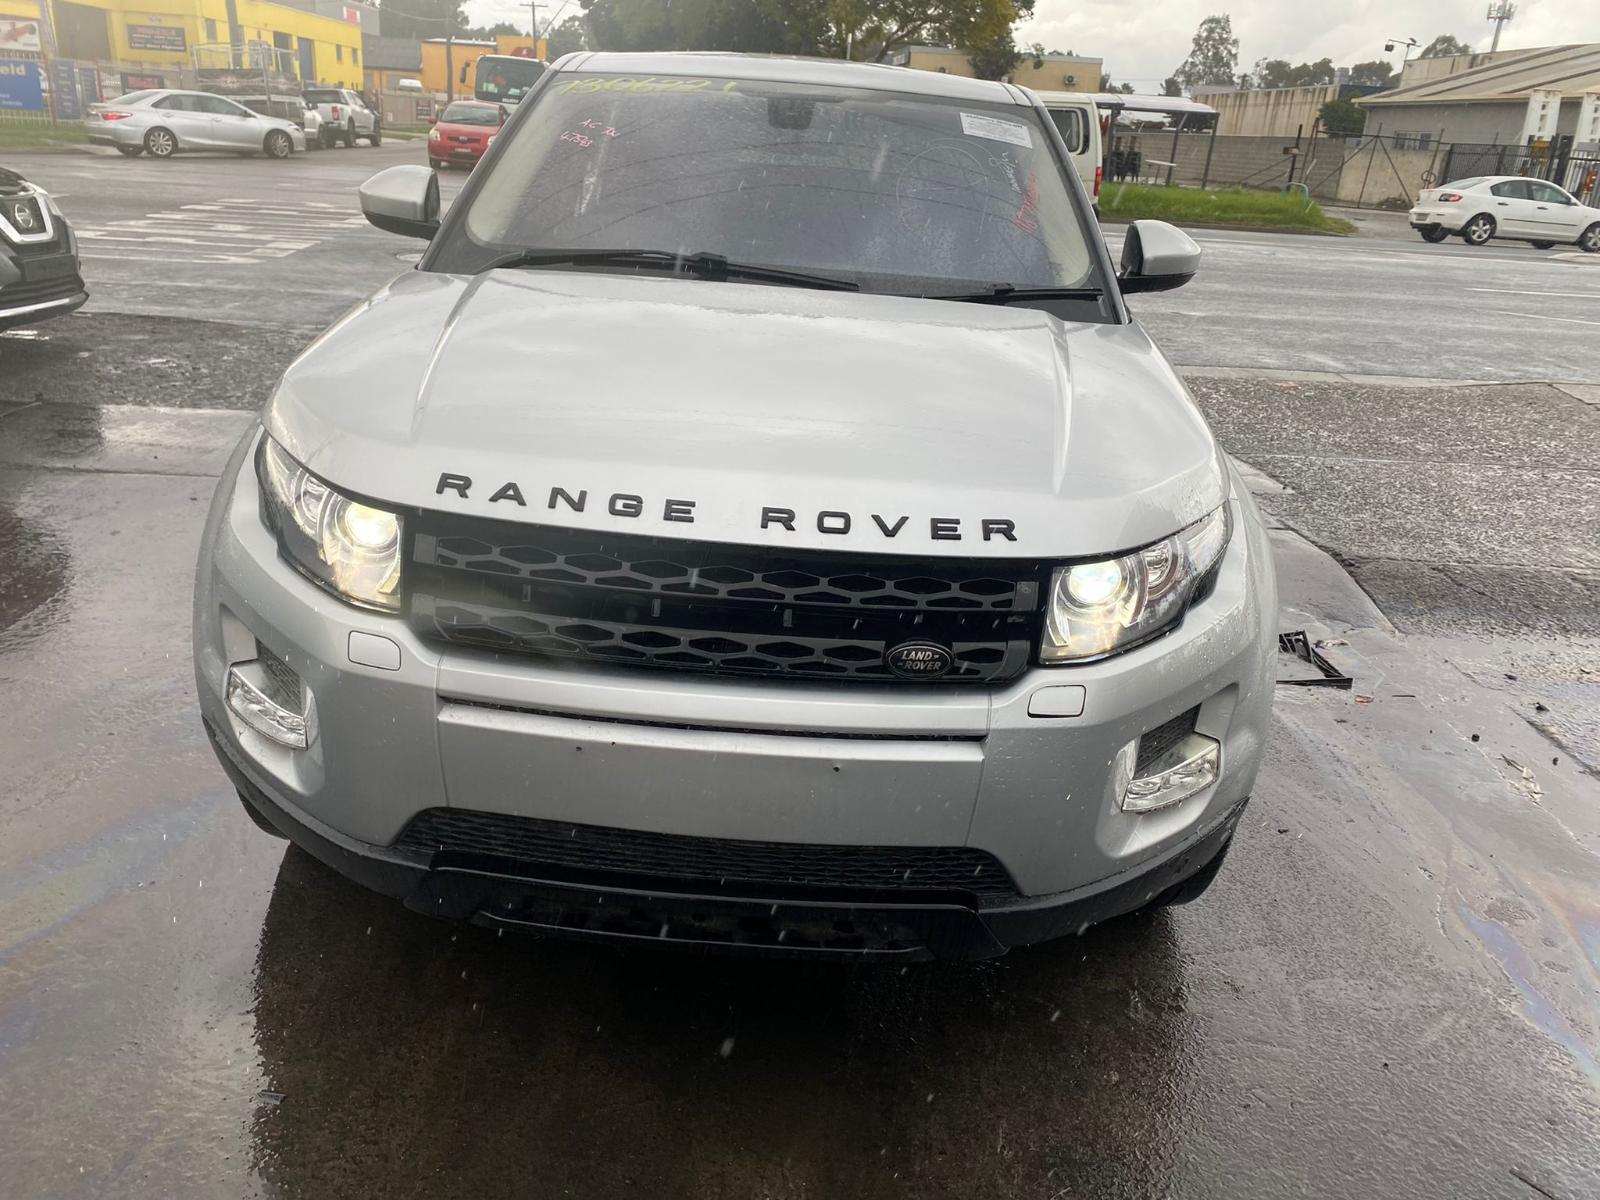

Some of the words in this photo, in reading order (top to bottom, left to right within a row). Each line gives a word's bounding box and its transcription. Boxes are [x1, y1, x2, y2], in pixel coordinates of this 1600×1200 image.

[436, 472, 697, 524] RANGE
[760, 506, 1018, 542] ROVER
[901, 650, 933, 661] LAND
[903, 660, 942, 671] ROVER
